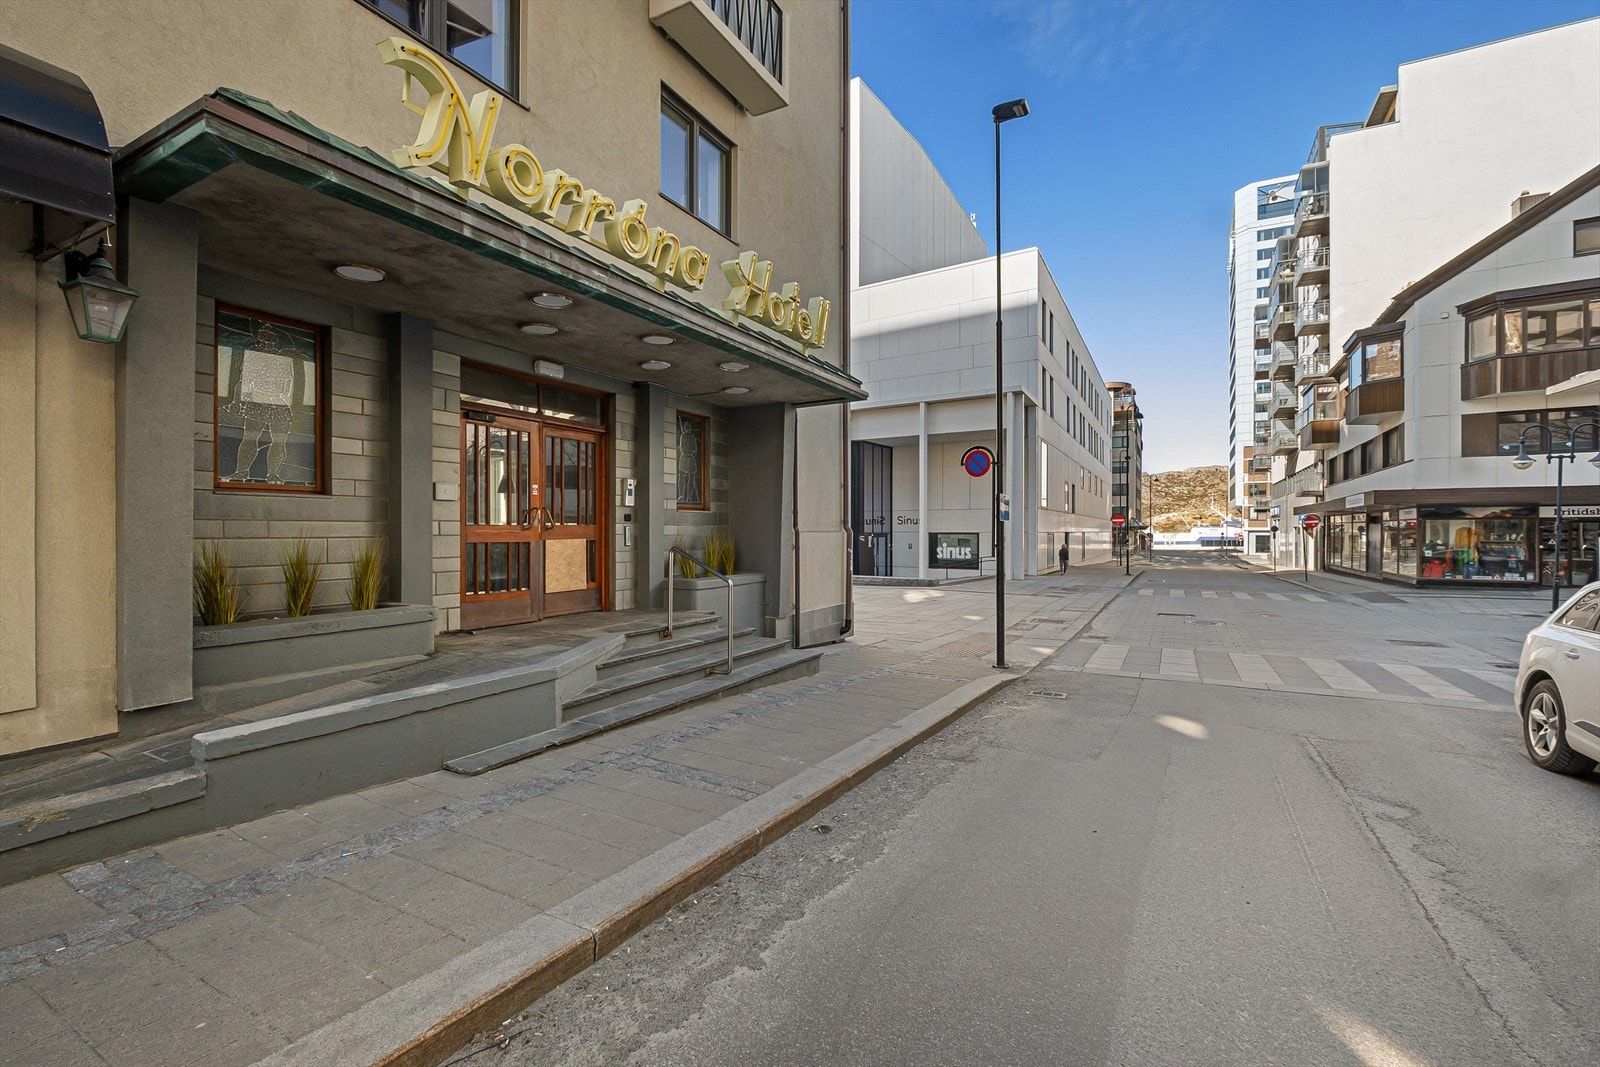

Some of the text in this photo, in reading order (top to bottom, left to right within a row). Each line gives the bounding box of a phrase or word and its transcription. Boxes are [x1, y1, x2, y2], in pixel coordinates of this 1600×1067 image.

[721, 250, 831, 348] Hotell
[897, 515, 920, 525] Sinu
[936, 543, 972, 559] sinus
